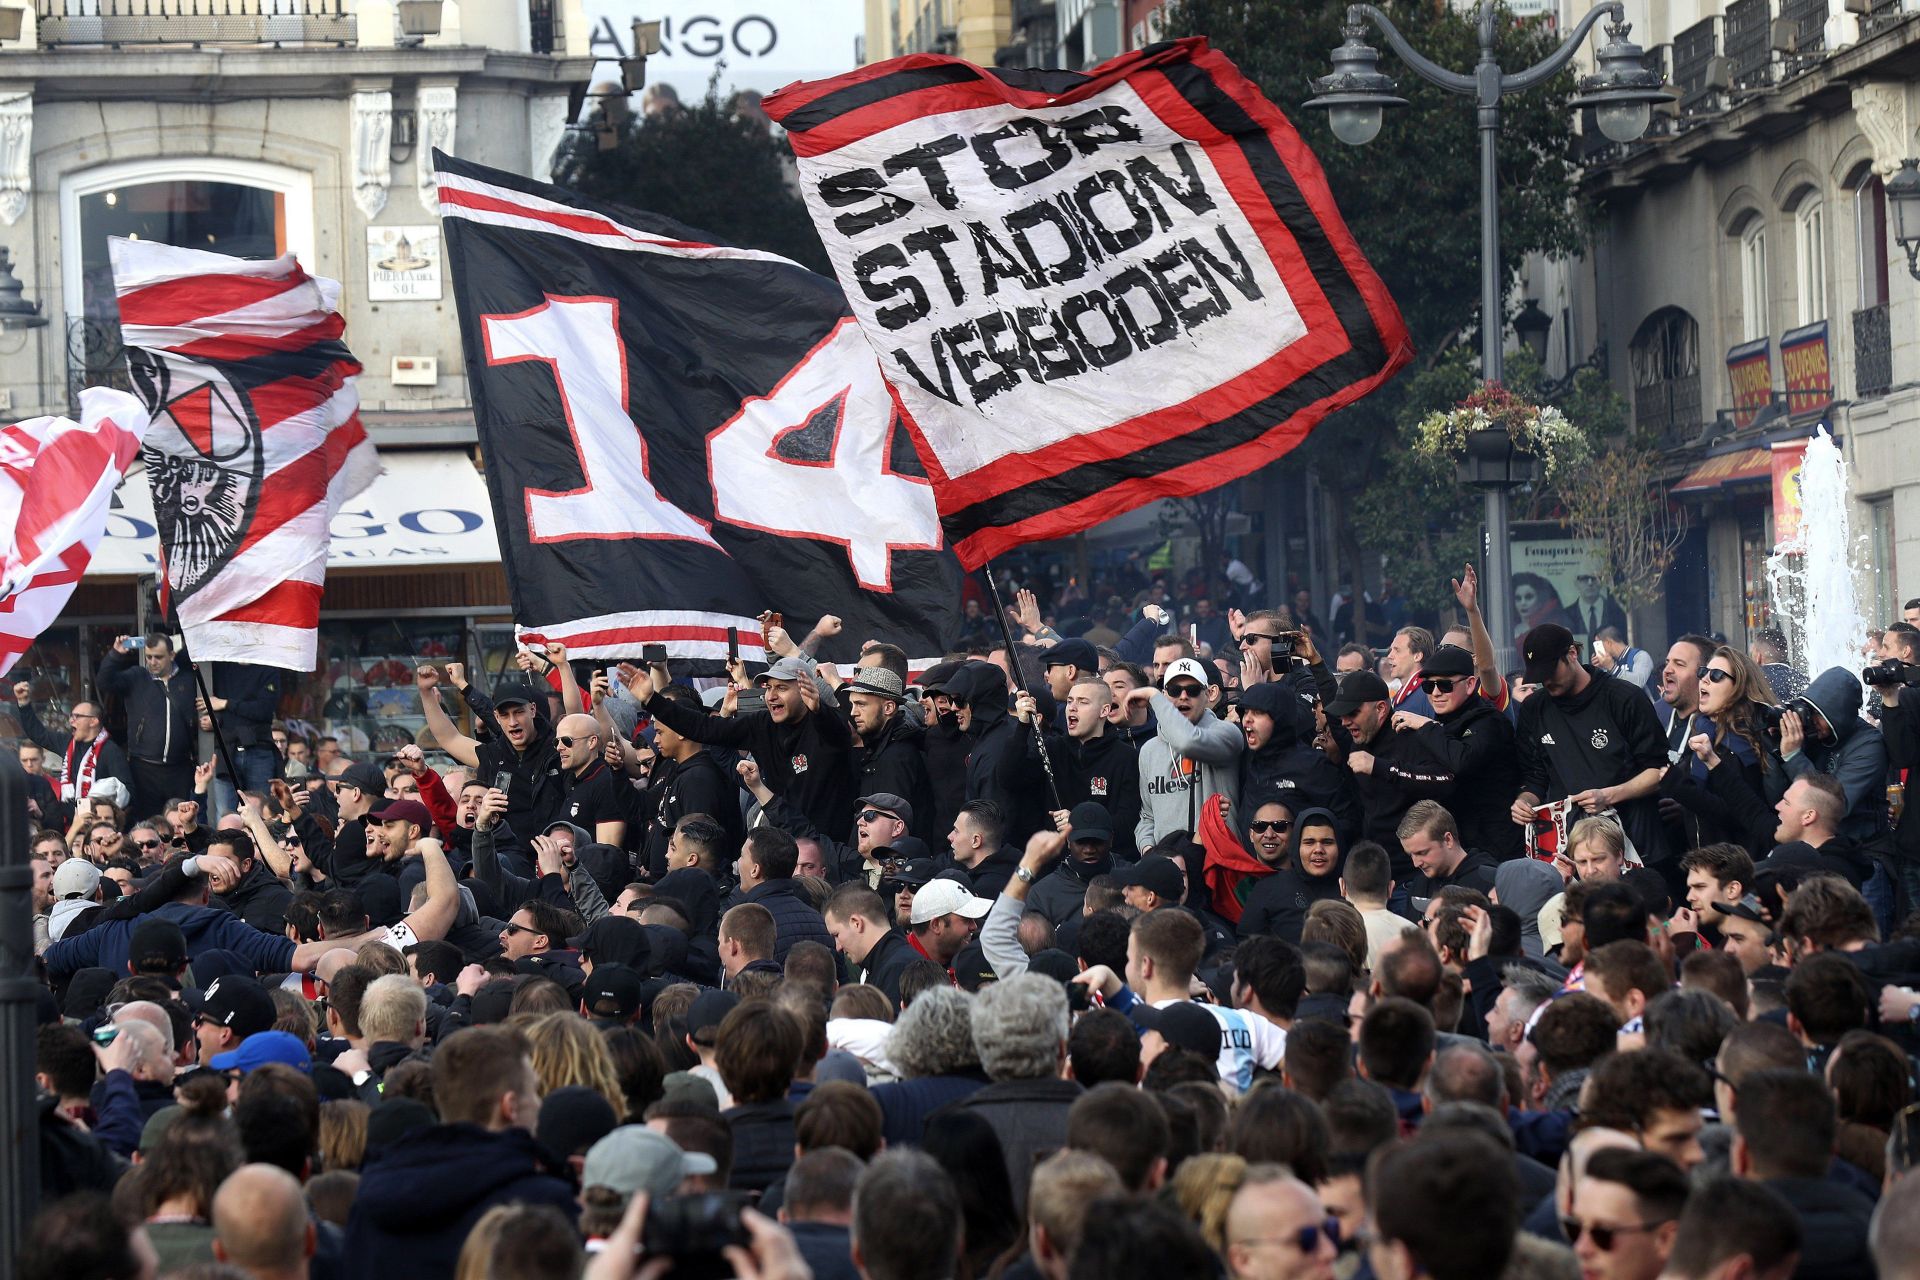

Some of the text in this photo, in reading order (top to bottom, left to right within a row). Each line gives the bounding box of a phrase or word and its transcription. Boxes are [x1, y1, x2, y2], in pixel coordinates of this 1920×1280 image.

[817, 105, 1143, 238] STOP
[373, 271, 416, 281] PUERTA
[851, 142, 1218, 331] STADION
[393, 283, 418, 294] SOL
[891, 224, 1267, 408] VERBODEN
[1729, 359, 1772, 398] SOUVENIRS
[1783, 342, 1827, 383] SOUVENIRS
[480, 293, 943, 593] 14
